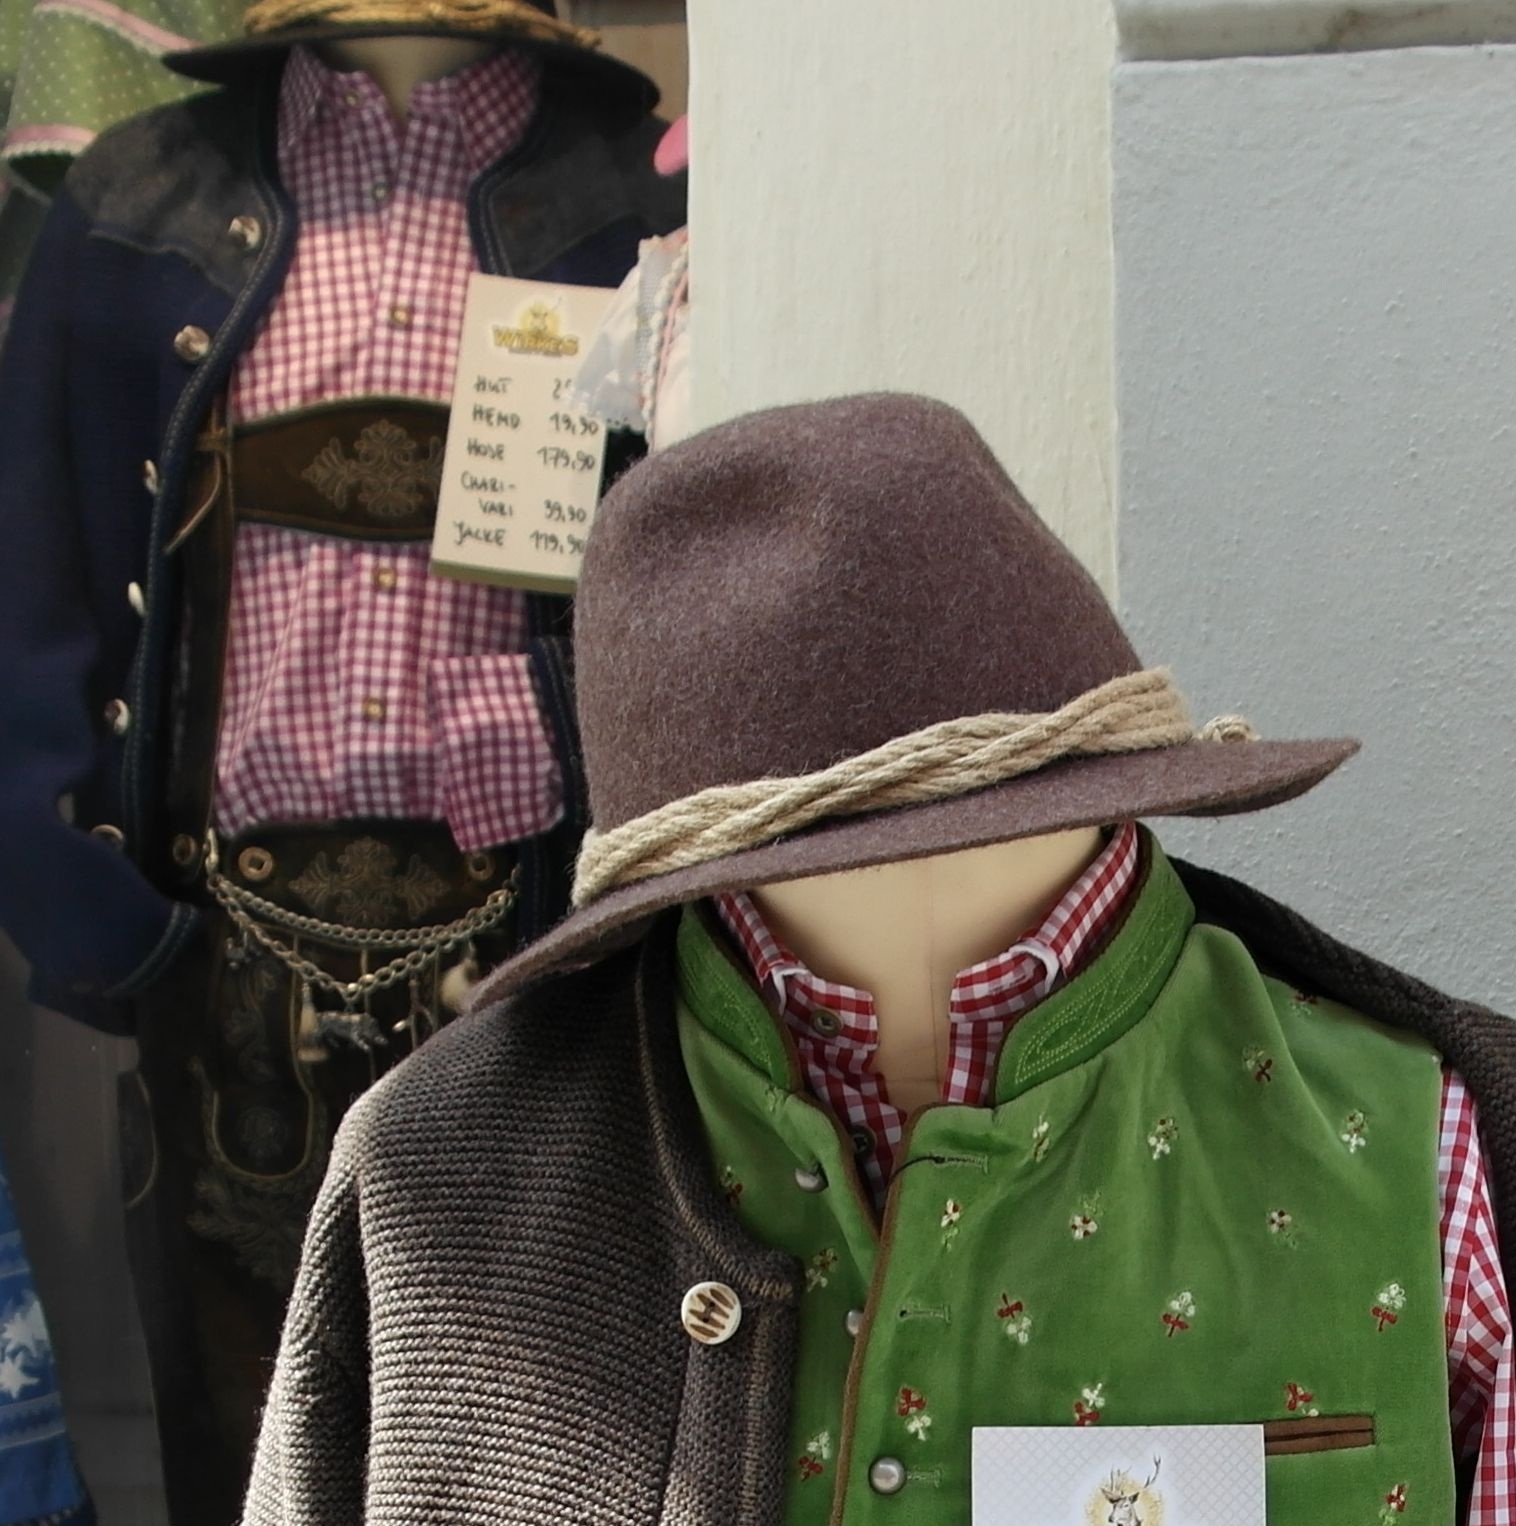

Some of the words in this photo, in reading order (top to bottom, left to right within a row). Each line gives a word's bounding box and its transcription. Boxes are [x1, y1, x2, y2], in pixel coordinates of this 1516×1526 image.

[472, 403, 521, 430] HEMD
[466, 437, 505, 461] HOSE
[478, 497, 513, 517] VARI
[453, 520, 506, 546] JACKE
